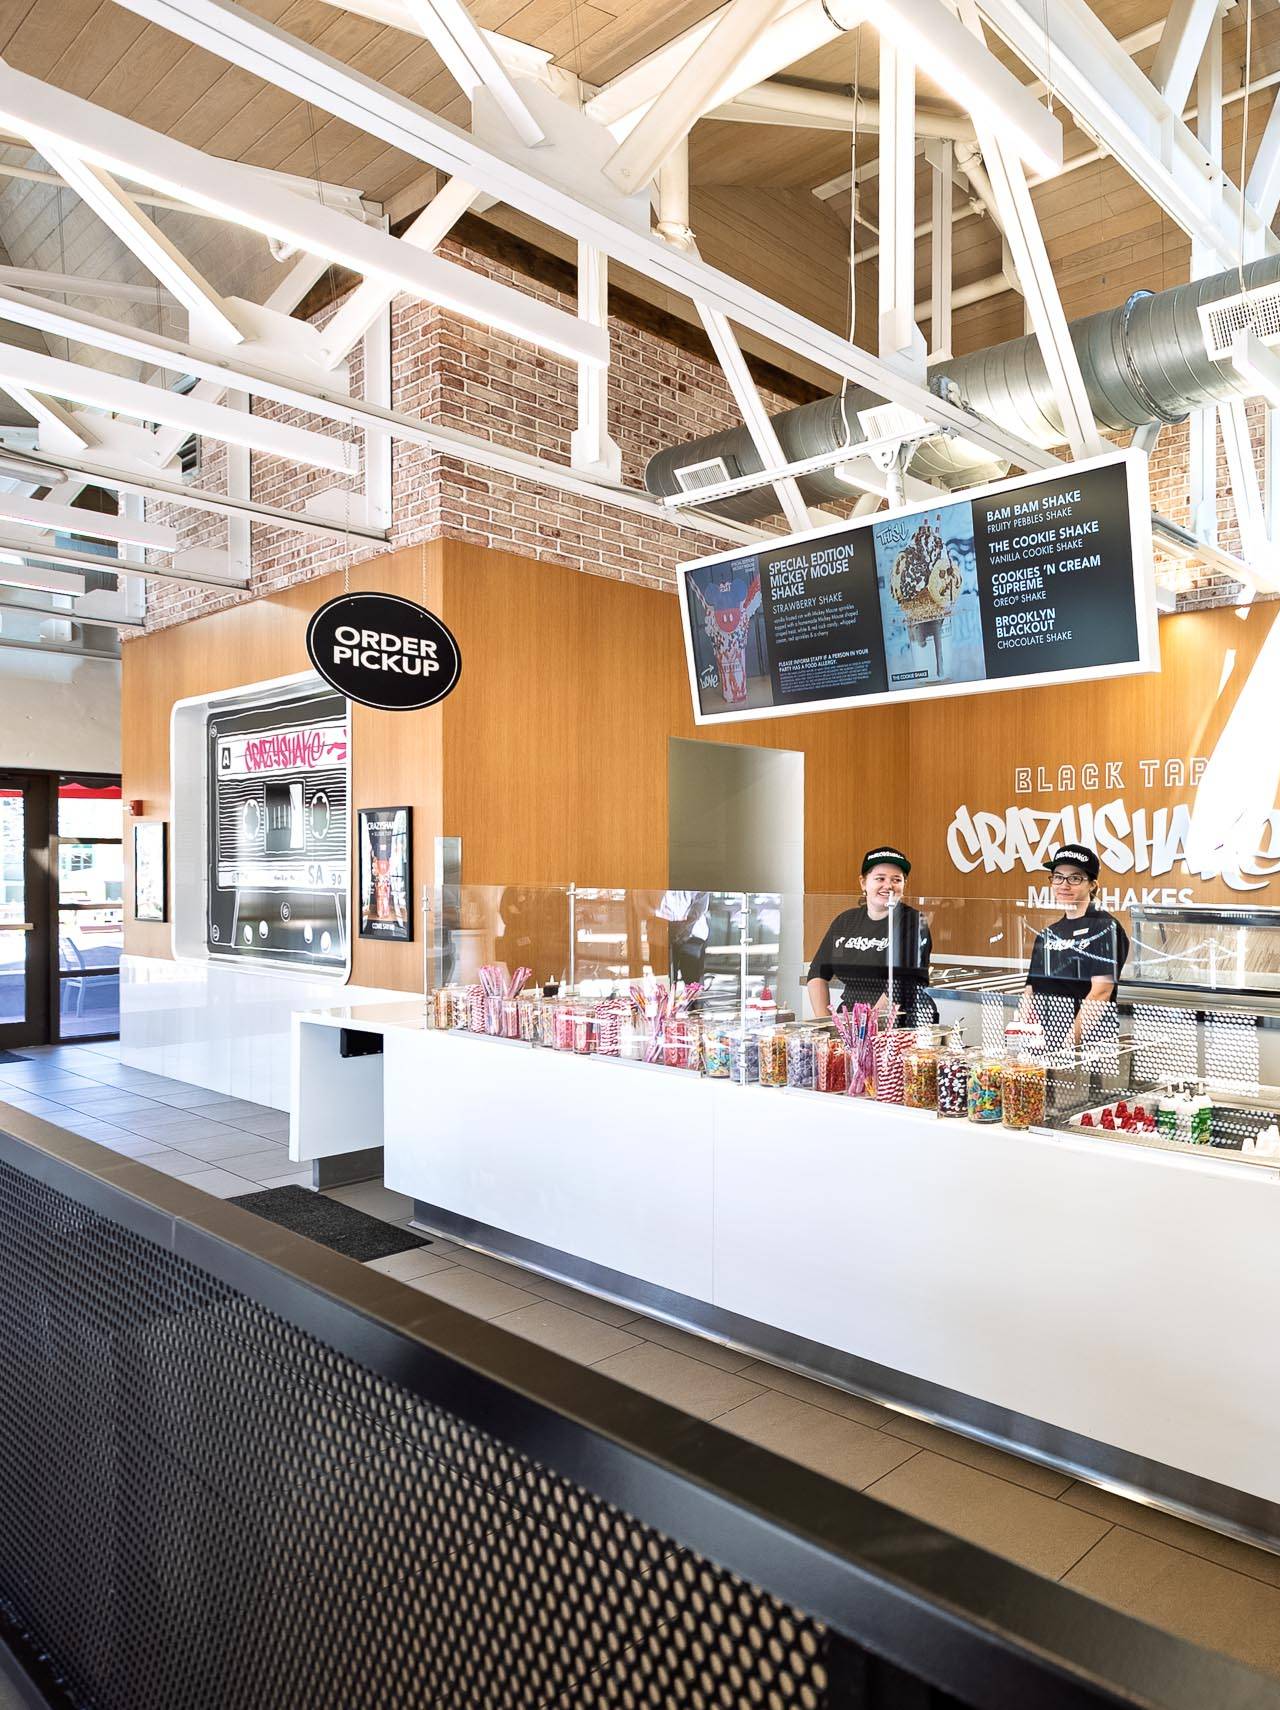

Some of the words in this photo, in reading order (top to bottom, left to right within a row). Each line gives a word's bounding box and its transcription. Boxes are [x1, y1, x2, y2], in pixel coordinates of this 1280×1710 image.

[986, 508, 1010, 522] BAM
[1013, 502, 1038, 517] BAM
[1041, 490, 1081, 511] SHAKE
[987, 519, 1011, 533] FRUITY
[1013, 514, 1044, 529] PEBBLES
[1047, 507, 1072, 521] SHAKE
[989, 541, 1009, 554] THE
[1012, 532, 1054, 550] COOKIE
[1057, 520, 1099, 542] SHAKE
[768, 556, 809, 575] SPECIAL
[811, 544, 854, 565] EDITION
[990, 552, 1021, 565] VANILLA
[1023, 545, 1054, 560] COOKIE
[1056, 538, 1083, 552] SHAKE
[770, 570, 809, 589] MICKEY
[811, 559, 849, 579] MOUSE
[991, 569, 1039, 585] COOKIES
[1059, 554, 1101, 574] CREAM
[771, 584, 805, 601] SHAKE
[992, 577, 1044, 596] SUPREME
[1021, 590, 1046, 603] SHAKE
[772, 596, 816, 614] STRAWBERRY
[818, 591, 842, 606] SHAKE
[995, 608, 1056, 627] BROOKLYN
[997, 619, 1055, 637] BLACKOUT
[334, 626, 438, 658] ORDER
[997, 635, 1042, 650] CHOCOLATE
[1044, 631, 1072, 643] SHAKE
[333, 645, 440, 677] PICKUP
[222, 749, 230, 768] A
[1015, 762, 1125, 793] BLACK
